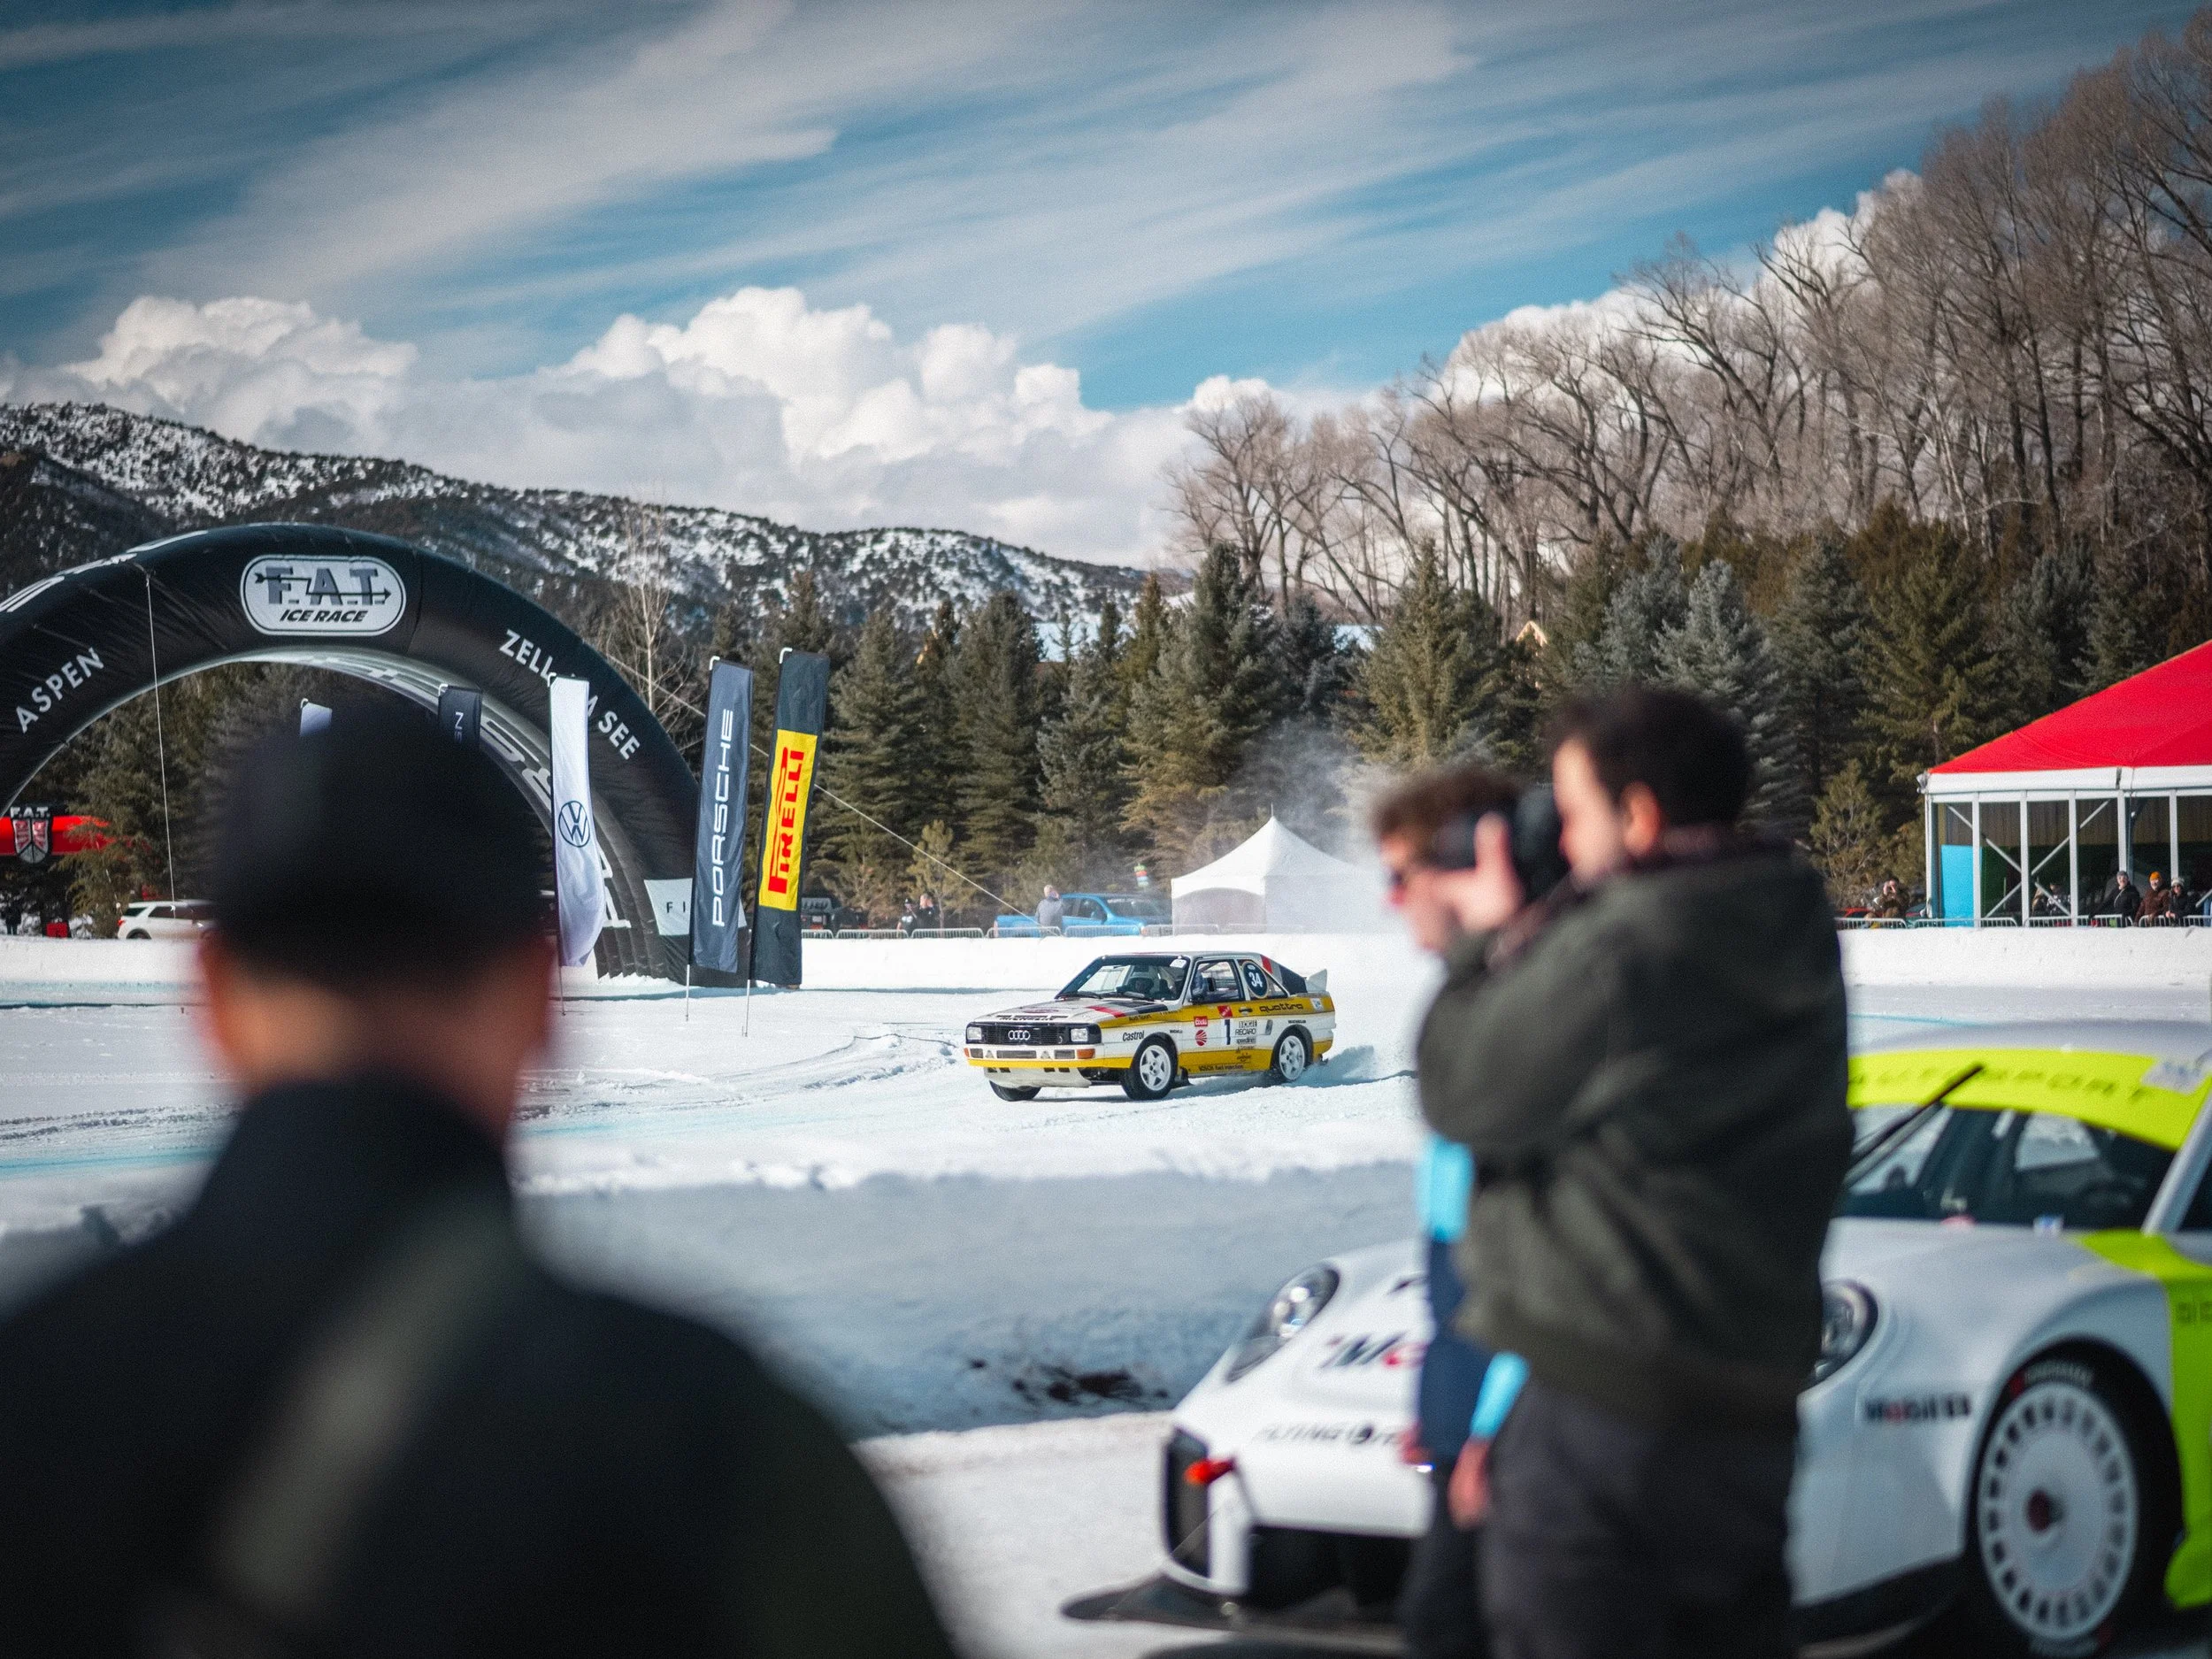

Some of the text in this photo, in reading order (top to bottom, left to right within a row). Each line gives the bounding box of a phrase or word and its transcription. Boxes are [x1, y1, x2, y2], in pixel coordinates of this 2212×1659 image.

[265, 566, 386, 606] F.A.T.
[279, 609, 368, 623] ICE RACE
[16, 647, 104, 733] ASPEN
[597, 710, 641, 760] SEE
[10, 806, 50, 818] F.A.T.
[711, 708, 733, 927] PORSCHE
[767, 747, 804, 895] PIRELLI
[1248, 972, 1263, 987] 34
[1259, 1002, 1303, 1012] quattro
[1122, 1030, 1144, 1041] Castrol
[1224, 1019, 1231, 1045] 1
